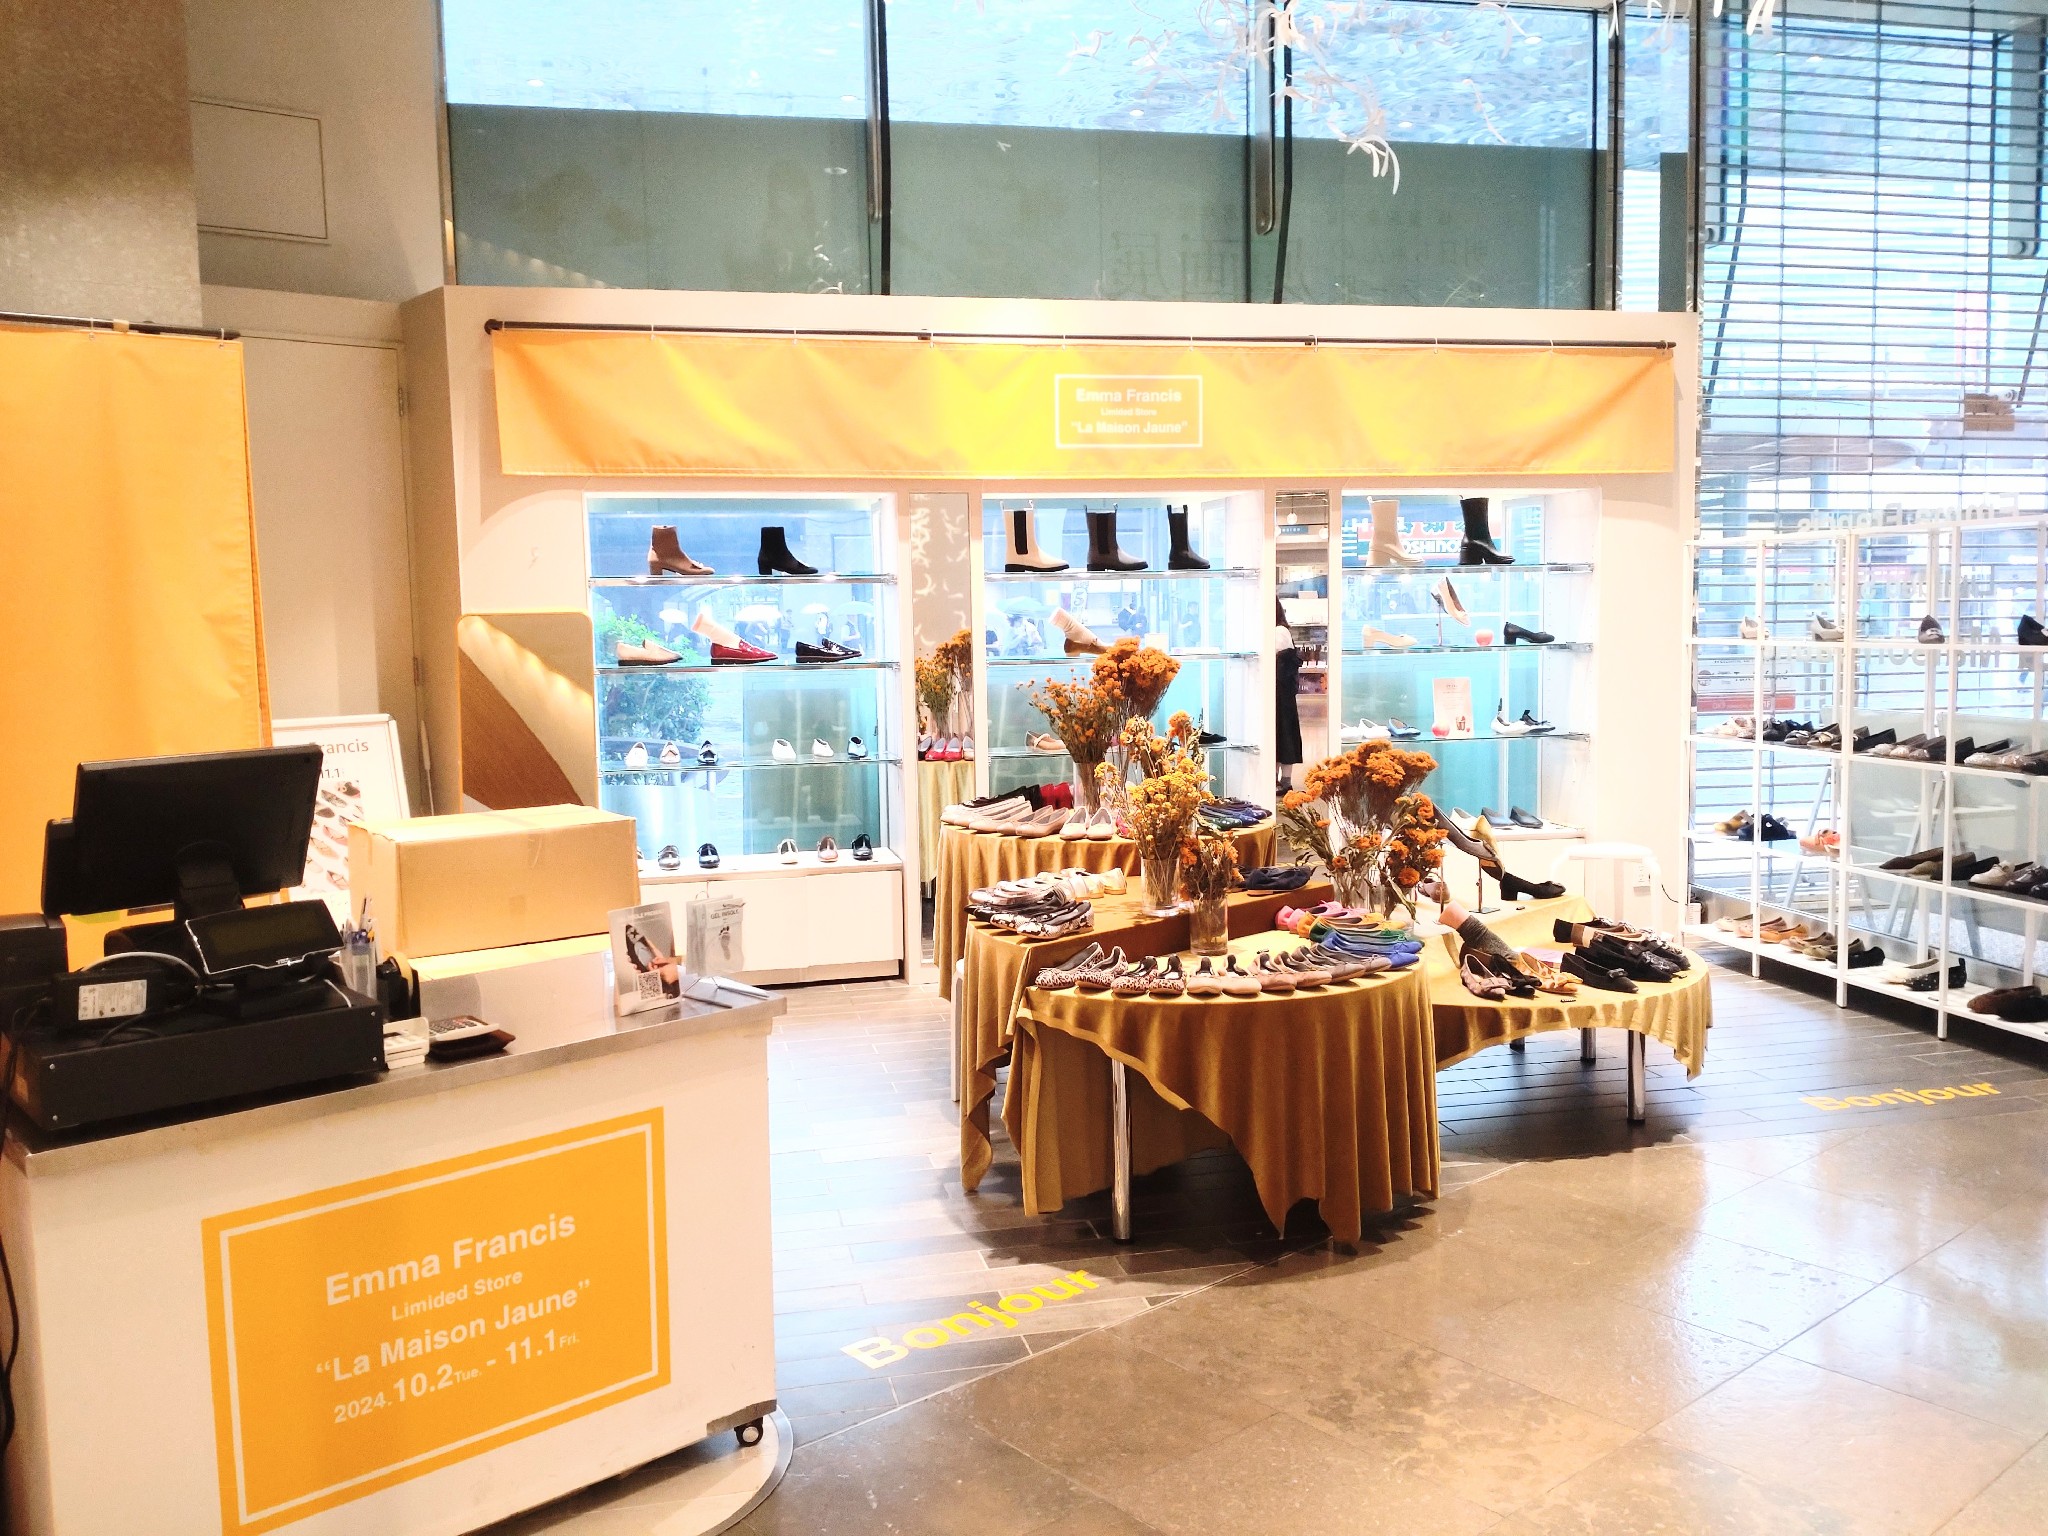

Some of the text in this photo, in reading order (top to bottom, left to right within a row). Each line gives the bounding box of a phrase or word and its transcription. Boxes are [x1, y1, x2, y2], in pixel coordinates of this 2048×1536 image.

[1076, 388, 1181, 402] Emma Francis
[1135, 408, 1157, 416] Store
[1096, 421, 1140, 433] Maison
[313, 739, 369, 754] rancis
[1798, 1082, 2001, 1111] Bonjour
[325, 1212, 577, 1306] Emma Francis
[391, 1270, 523, 1322] Limided Store
[840, 1270, 1100, 1370] Bonjour
[380, 1317, 487, 1367] Maison
